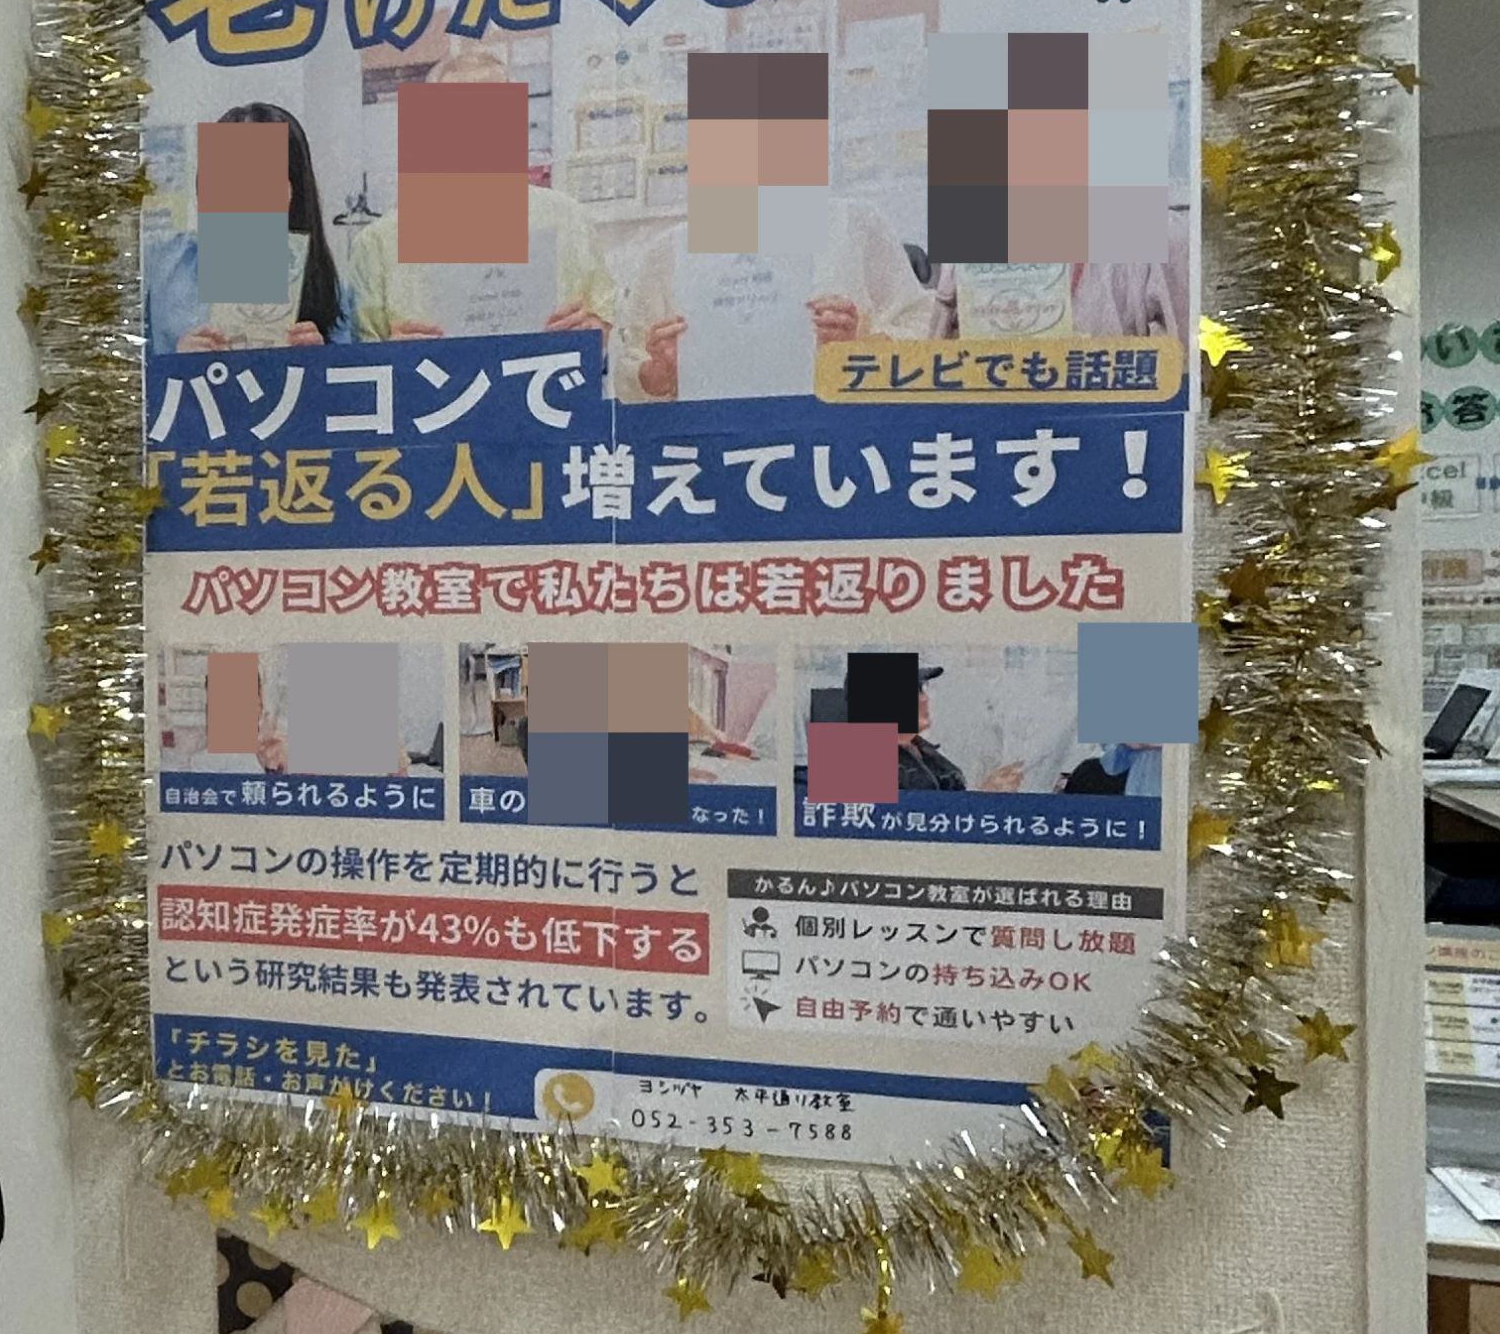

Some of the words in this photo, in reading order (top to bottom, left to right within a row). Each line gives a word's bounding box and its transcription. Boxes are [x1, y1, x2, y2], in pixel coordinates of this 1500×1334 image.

[842, 347, 1159, 391] テレビでも話題
[149, 351, 586, 442] パソコンで
[147, 429, 1150, 526] 「若返る人」増えています！
[183, 553, 1124, 615] パソコン教室で私たちは若返りました
[164, 779, 436, 810] 自治会で頼られるように
[468, 787, 526, 814] 車の
[802, 801, 1147, 840] 詐欺が見分けられるように！
[161, 841, 700, 897] パソコンの操作を定期的に行うと
[160, 897, 702, 963] 認知症発症率が43%も低下する
[795, 916, 1137, 955] 個別レッスンで質問し放題
[165, 956, 708, 1024] という研究結果も発表されています。
[795, 956, 1092, 993] パソコンの持ち込みOK
[795, 997, 1074, 1035] 自由予約で通いやすい
[630, 1107, 853, 1141] 052-353-7588
